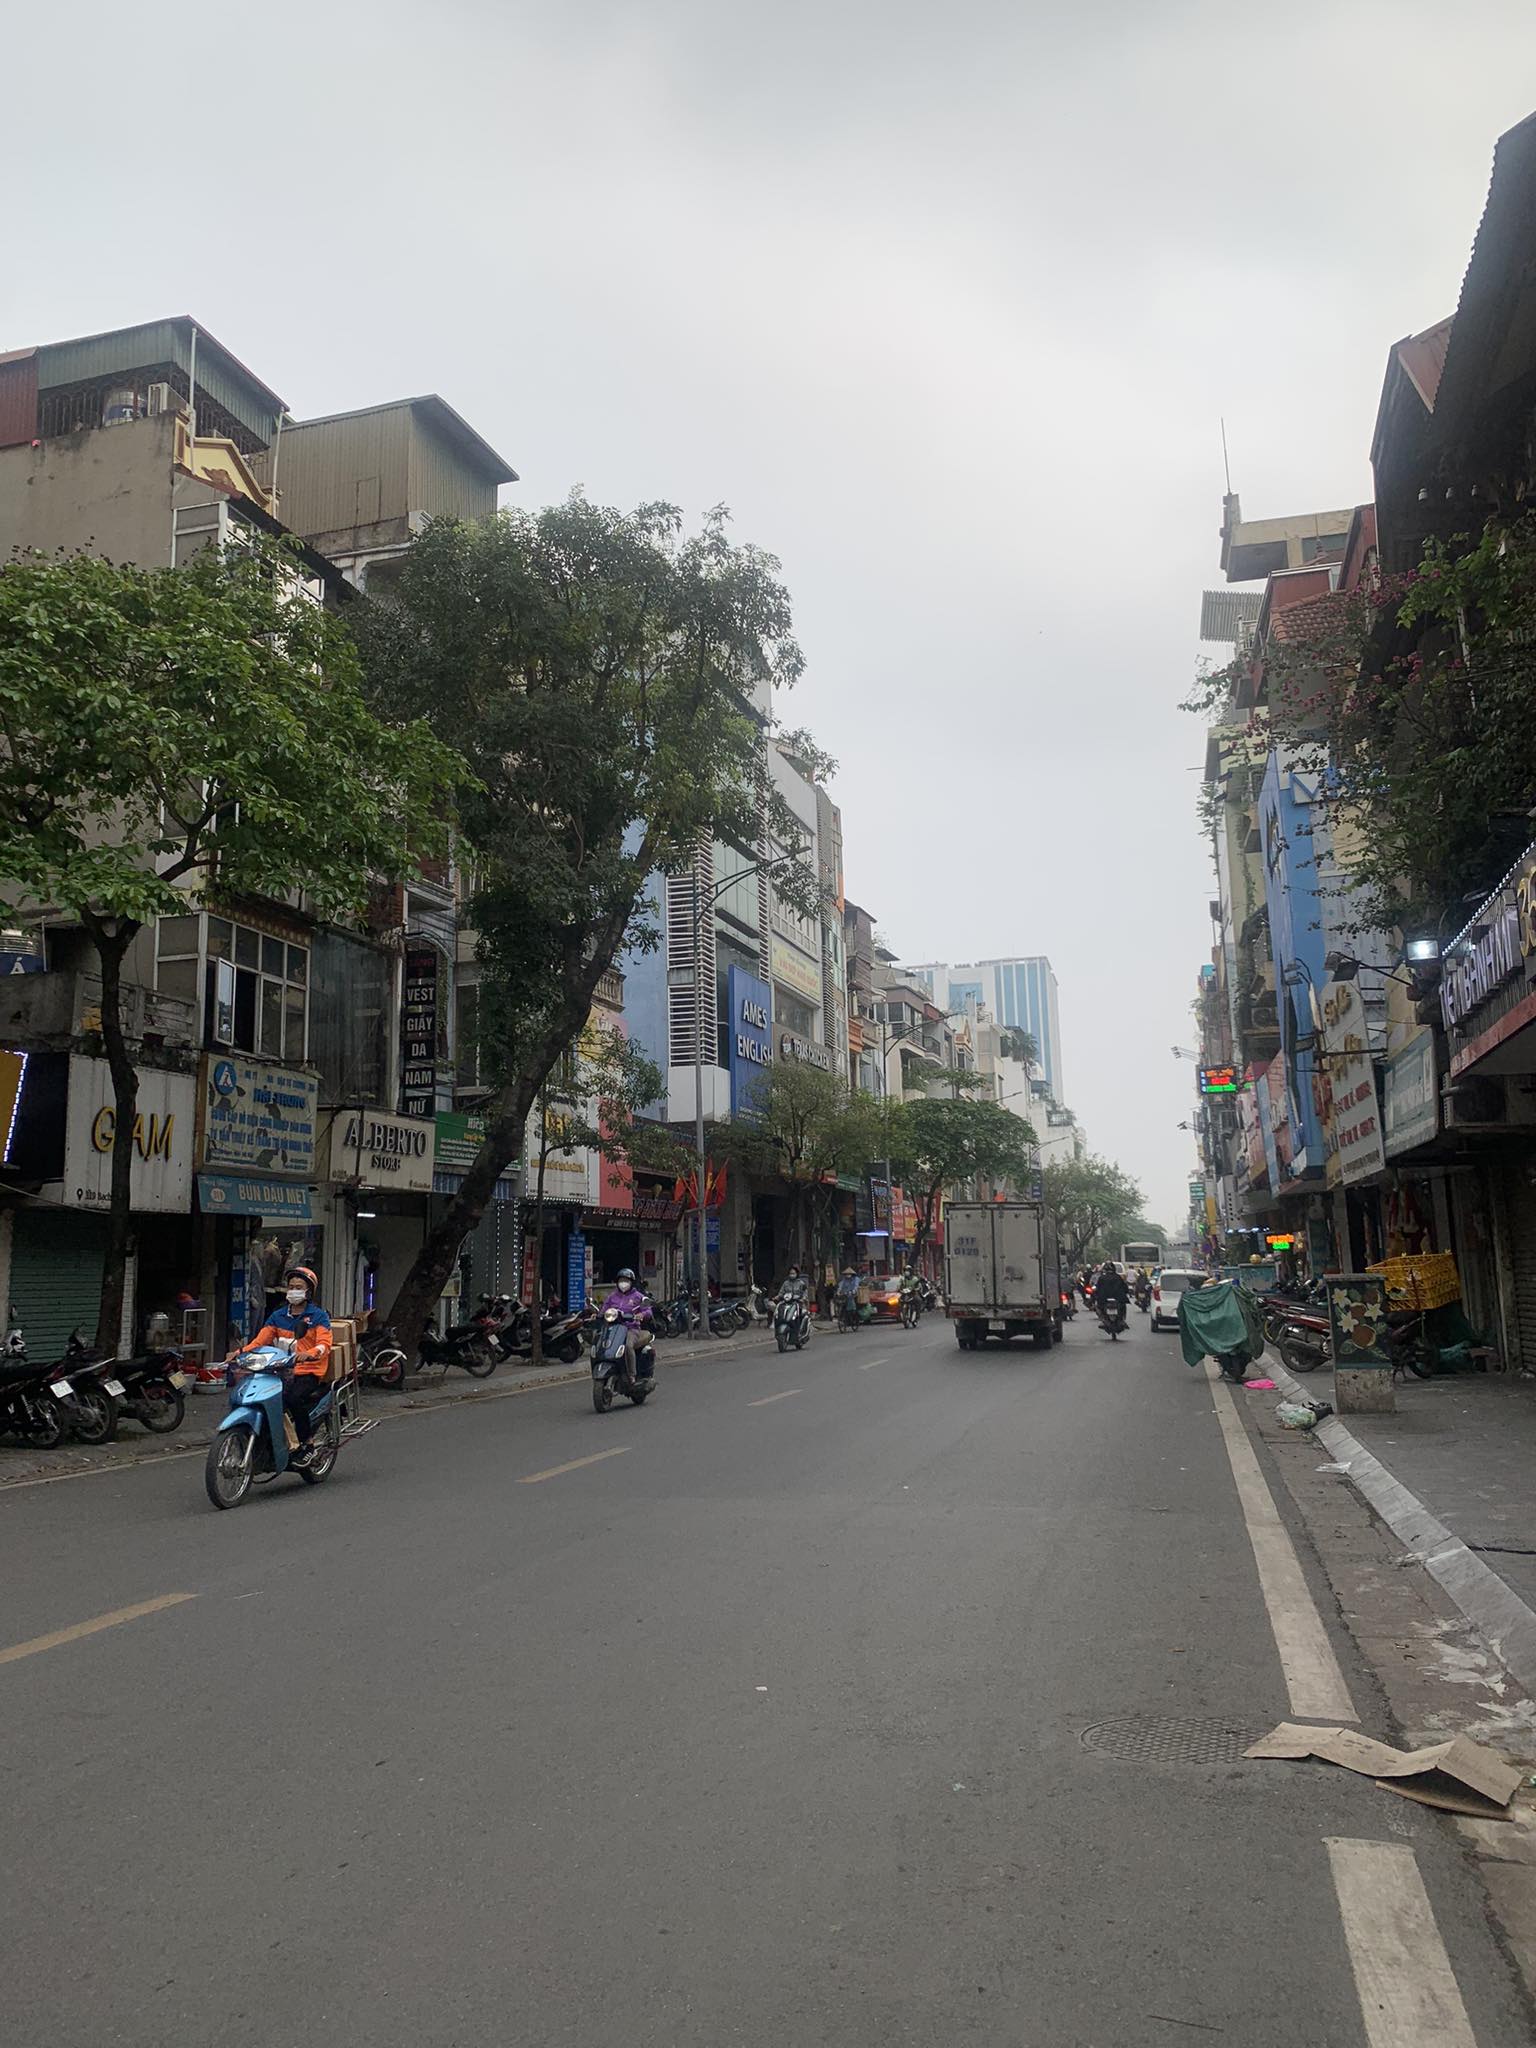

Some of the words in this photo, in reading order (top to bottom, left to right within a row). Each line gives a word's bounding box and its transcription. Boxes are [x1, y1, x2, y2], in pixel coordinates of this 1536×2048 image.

[406, 987, 435, 1001] VEST
[742, 999, 768, 1029] AMES
[411, 1042, 427, 1057] DA
[737, 1034, 774, 1065] ENGLISH
[405, 1071, 432, 1085] NAM
[346, 1118, 428, 1156] ALBERTO
[372, 1155, 402, 1171] STORE
[239, 1181, 261, 1201] BÚN
